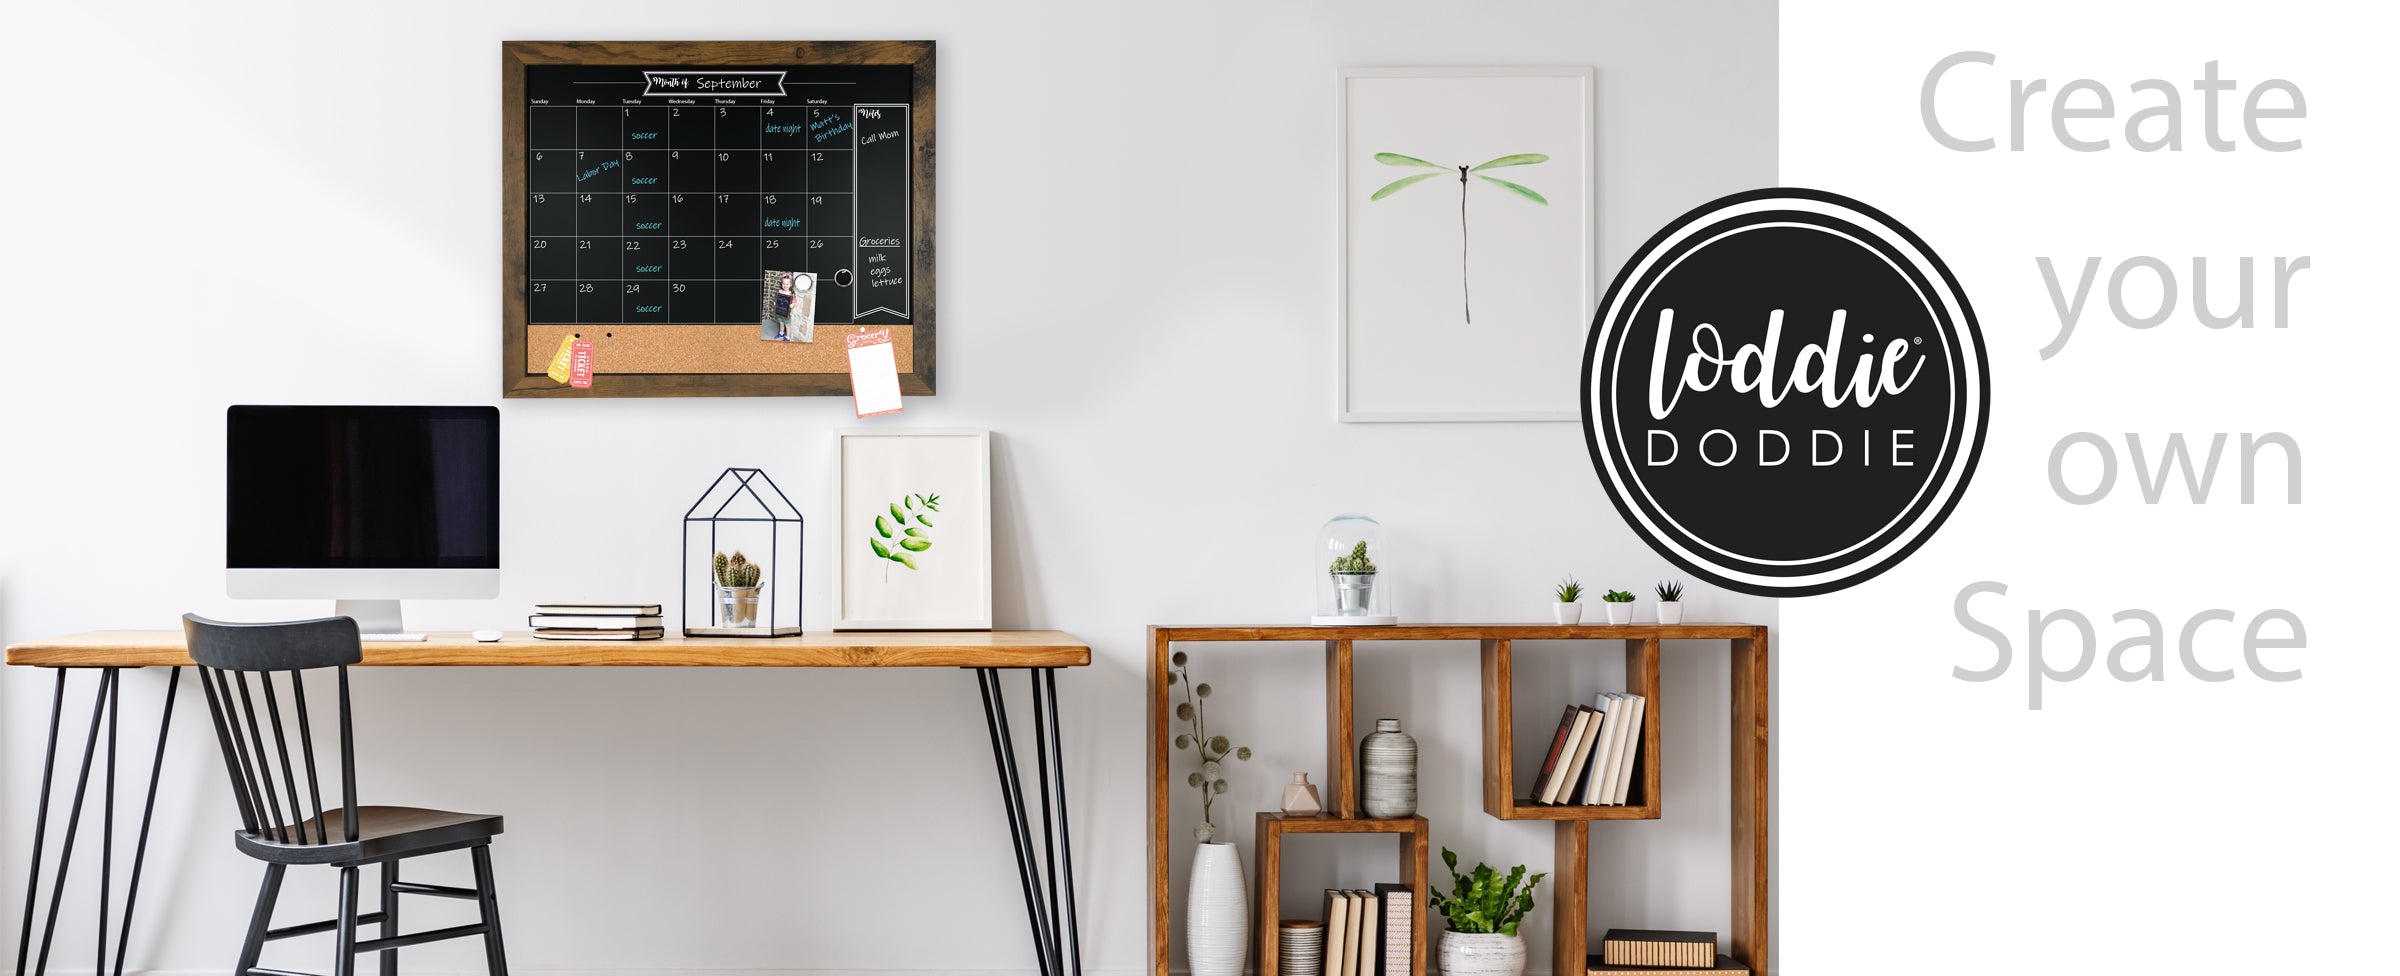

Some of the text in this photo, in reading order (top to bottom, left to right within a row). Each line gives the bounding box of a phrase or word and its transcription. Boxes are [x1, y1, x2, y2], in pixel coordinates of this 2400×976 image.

[652, 76, 681, 88] Month
[696, 77, 762, 91] September
[624, 108, 629, 117] 1
[672, 108, 680, 117] 2
[719, 107, 727, 118] 3
[766, 107, 775, 117] 4
[813, 108, 820, 118] 5
[810, 112, 841, 132] Matt's
[765, 122, 802, 137] date night
[814, 121, 854, 144] Birthday
[631, 132, 658, 140] soccer
[861, 130, 900, 145] Call Mom
[535, 151, 543, 161] 6
[578, 151, 585, 161] 7
[625, 151, 633, 161] 8
[671, 150, 679, 160] 9
[718, 152, 730, 162] 10
[763, 152, 773, 161] 11
[811, 152, 824, 162] 12
[576, 159, 620, 182] Labor Day
[631, 177, 658, 185] soccer
[532, 194, 546, 204] 13
[579, 194, 593, 204] 14
[625, 194, 637, 204] 15
[672, 194, 684, 204] 16
[718, 194, 729, 204] 17
[764, 194, 777, 205] 18
[810, 195, 823, 206] 19
[635, 222, 662, 230] soccer
[764, 217, 801, 231] date night
[533, 239, 547, 249] 20
[579, 240, 591, 249] 21
[672, 239, 687, 250] 23
[718, 239, 734, 249] 24
[766, 239, 780, 249] 25
[809, 239, 824, 249] 26
[858, 235, 901, 246] Groceries
[626, 241, 641, 251] 22
[868, 253, 887, 264] milk
[636, 265, 663, 273] soccer
[869, 266, 892, 277] eggs
[871, 276, 903, 288] lettuce
[533, 283, 547, 293] 27
[579, 283, 594, 293] 28
[626, 284, 640, 294] 29
[672, 283, 686, 293] 30
[636, 305, 663, 313] soccer
[577, 351, 586, 377] TICKET
